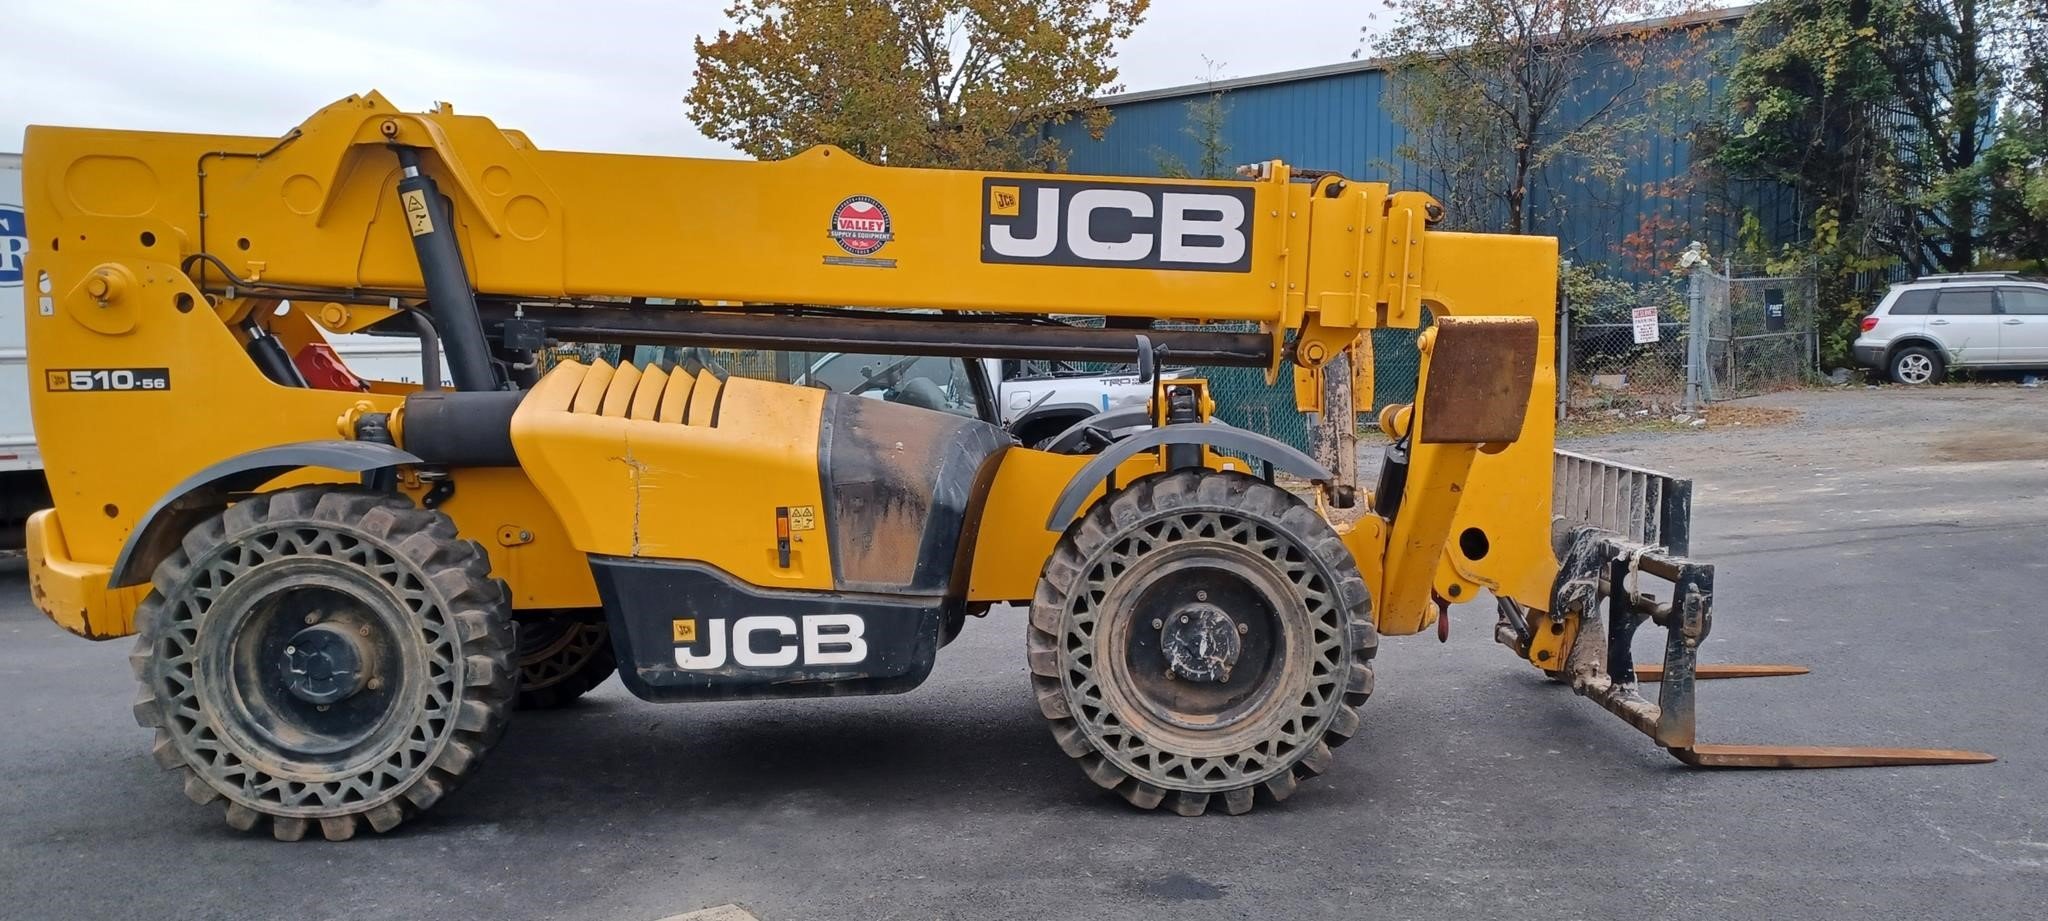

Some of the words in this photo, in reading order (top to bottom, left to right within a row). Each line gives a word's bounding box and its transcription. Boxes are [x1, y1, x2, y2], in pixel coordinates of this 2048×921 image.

[997, 193, 1015, 207] JCB
[839, 220, 884, 231] VALLEY
[990, 187, 1246, 264] JCB
[70, 369, 165, 391] 510-56
[1100, 378, 1131, 386] TRD
[675, 614, 868, 670] JCB
